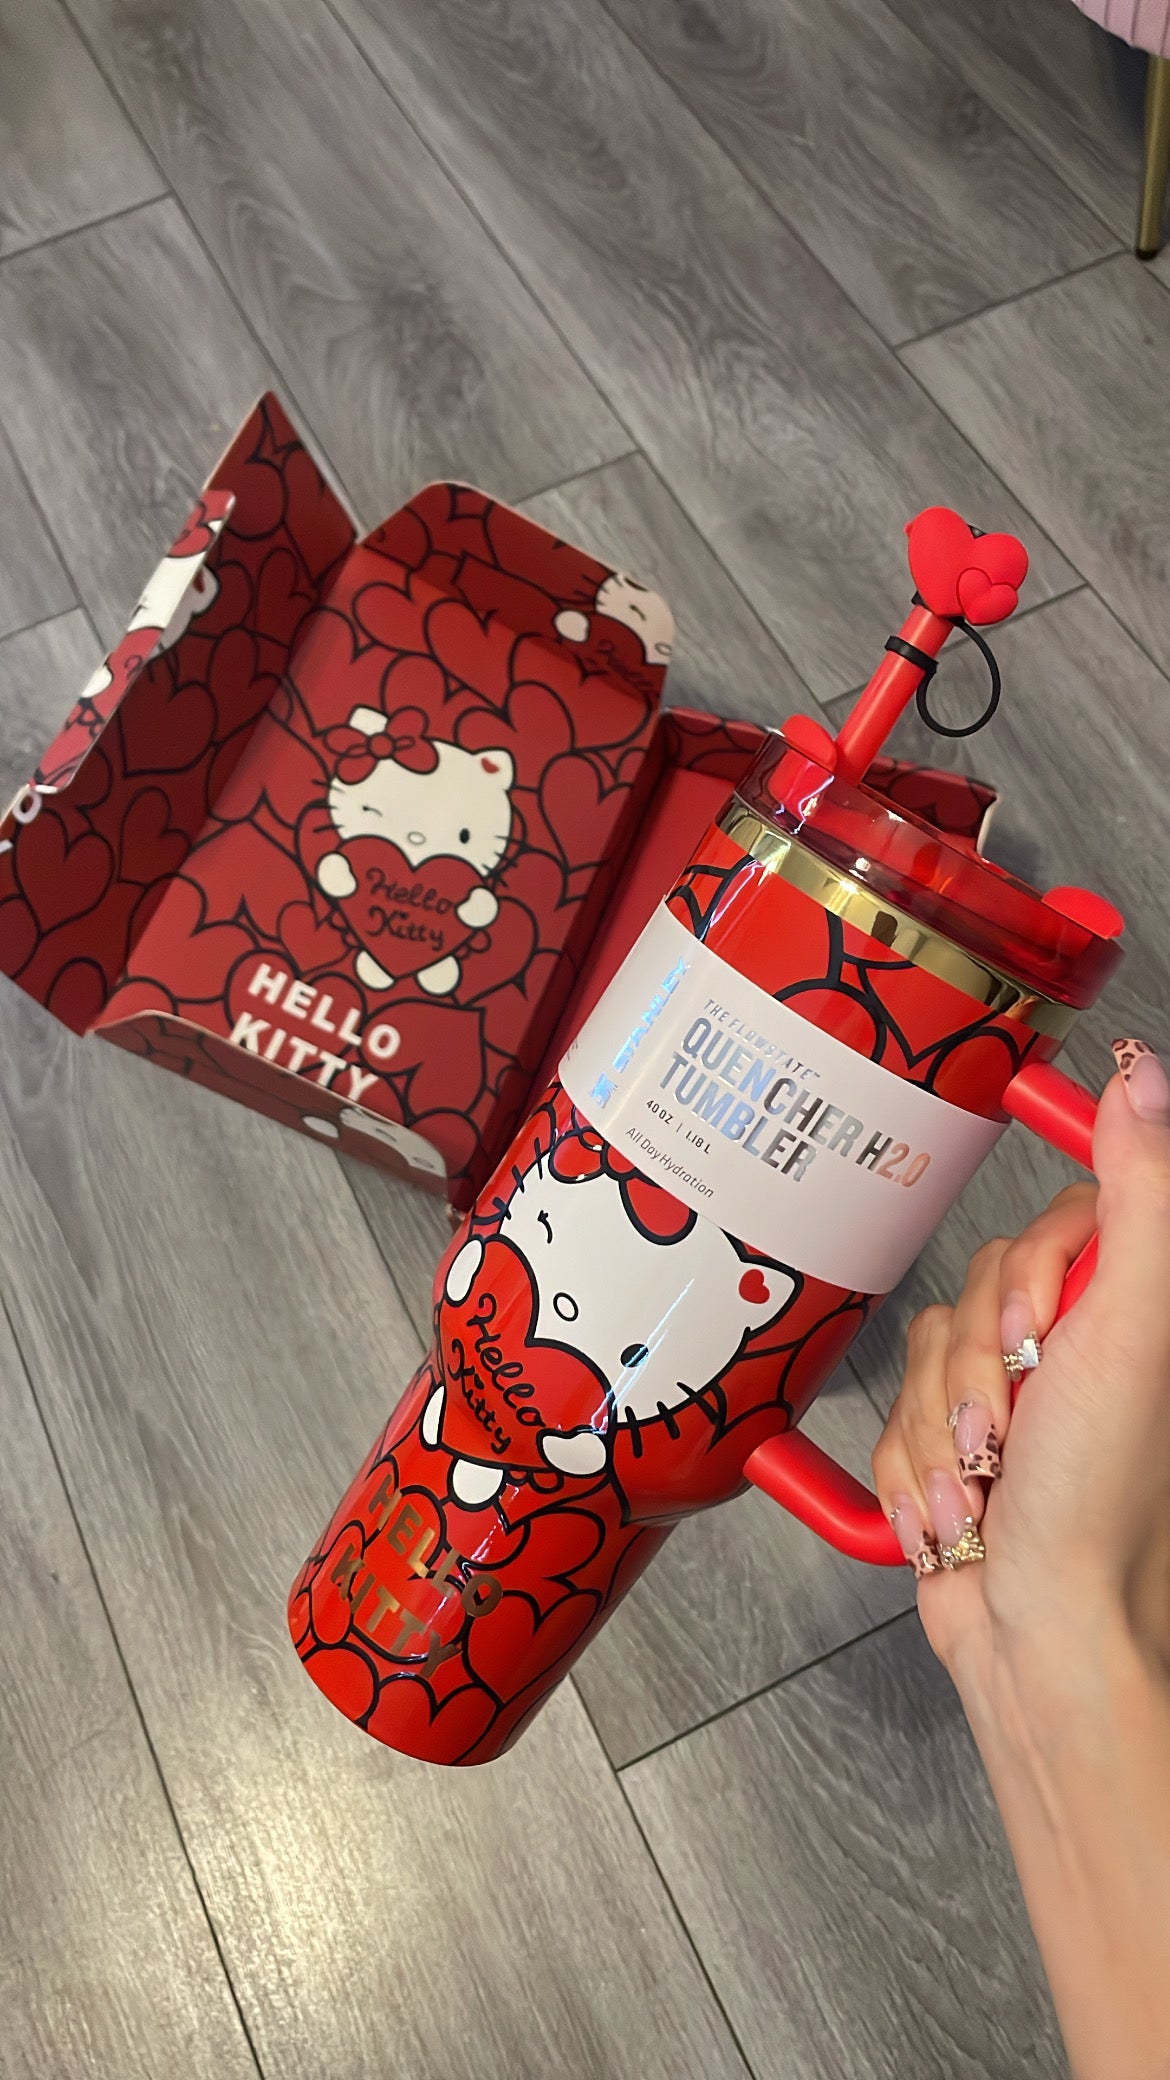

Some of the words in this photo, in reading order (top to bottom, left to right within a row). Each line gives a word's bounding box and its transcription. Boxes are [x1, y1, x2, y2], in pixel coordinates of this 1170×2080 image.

[366, 867, 450, 915] Hello
[366, 906, 444, 951] Kitty
[229, 1012, 379, 1102] KITTY
[248, 963, 401, 1058] HELLO
[612, 956, 688, 1074] STANLEY
[703, 999, 730, 1022] THE
[660, 1051, 817, 1183] TUMBLER
[681, 1017, 864, 1157] QUENCHER
[626, 1127, 643, 1143] All
[641, 1138, 661, 1160] Day
[659, 1154, 715, 1198] Hydration
[685, 1130, 704, 1148] 1.18
[704, 1144, 711, 1154] L
[448, 1339, 512, 1454] Kitty
[466, 1293, 545, 1428] Hello
[368, 1473, 503, 1617] HELLO
[330, 1544, 462, 1678] KITTY
